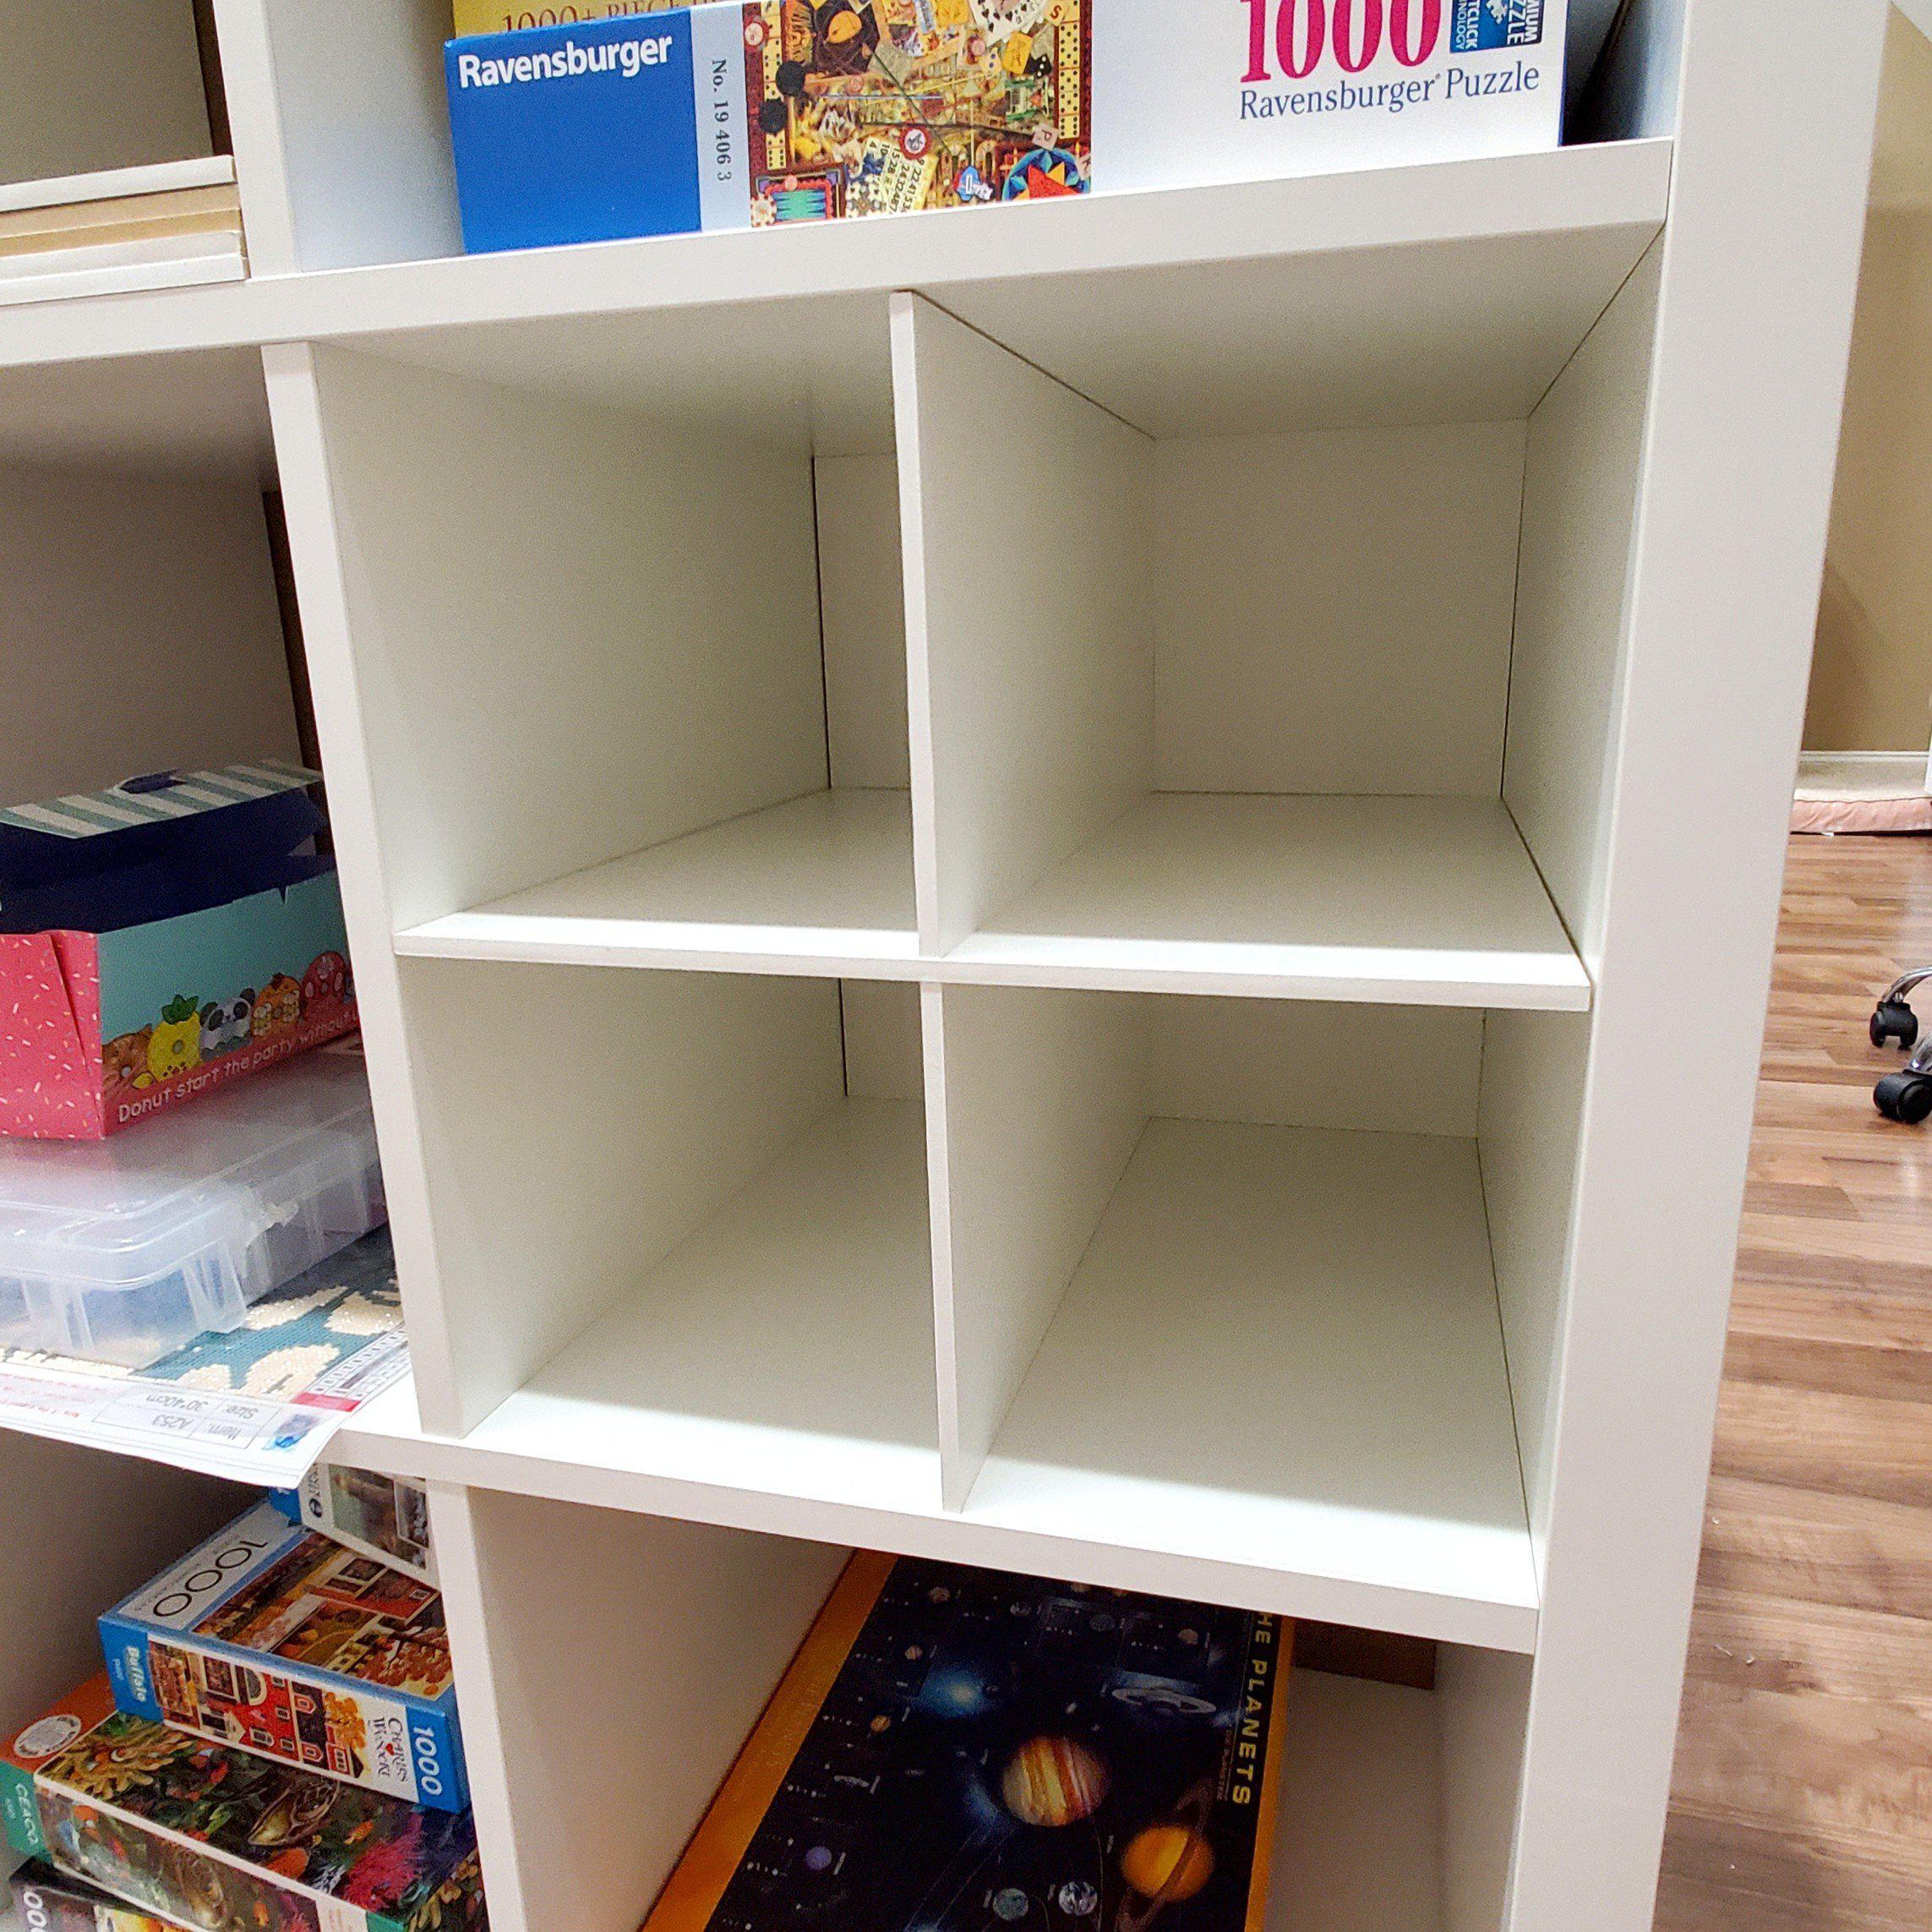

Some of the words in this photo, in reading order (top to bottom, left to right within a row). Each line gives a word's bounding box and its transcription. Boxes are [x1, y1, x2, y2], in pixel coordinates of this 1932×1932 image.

[458, 35, 673, 88] Ravensburger
[1240, 0, 1441, 83] 1000
[712, 58, 727, 92] No.
[1239, 76, 1437, 120] Ravensburger
[1444, 61, 1540, 100] Puzzle
[714, 101, 729, 123] 19
[716, 130, 731, 165] 406
[117, 1088, 172, 1123] Donut
[176, 1067, 220, 1098] start
[224, 1057, 249, 1078] the
[254, 1038, 293, 1067] party
[153, 1539, 267, 1618] 1000
[413, 1727, 442, 1796] 1000
[1232, 1659, 1268, 1804] PLANETS
